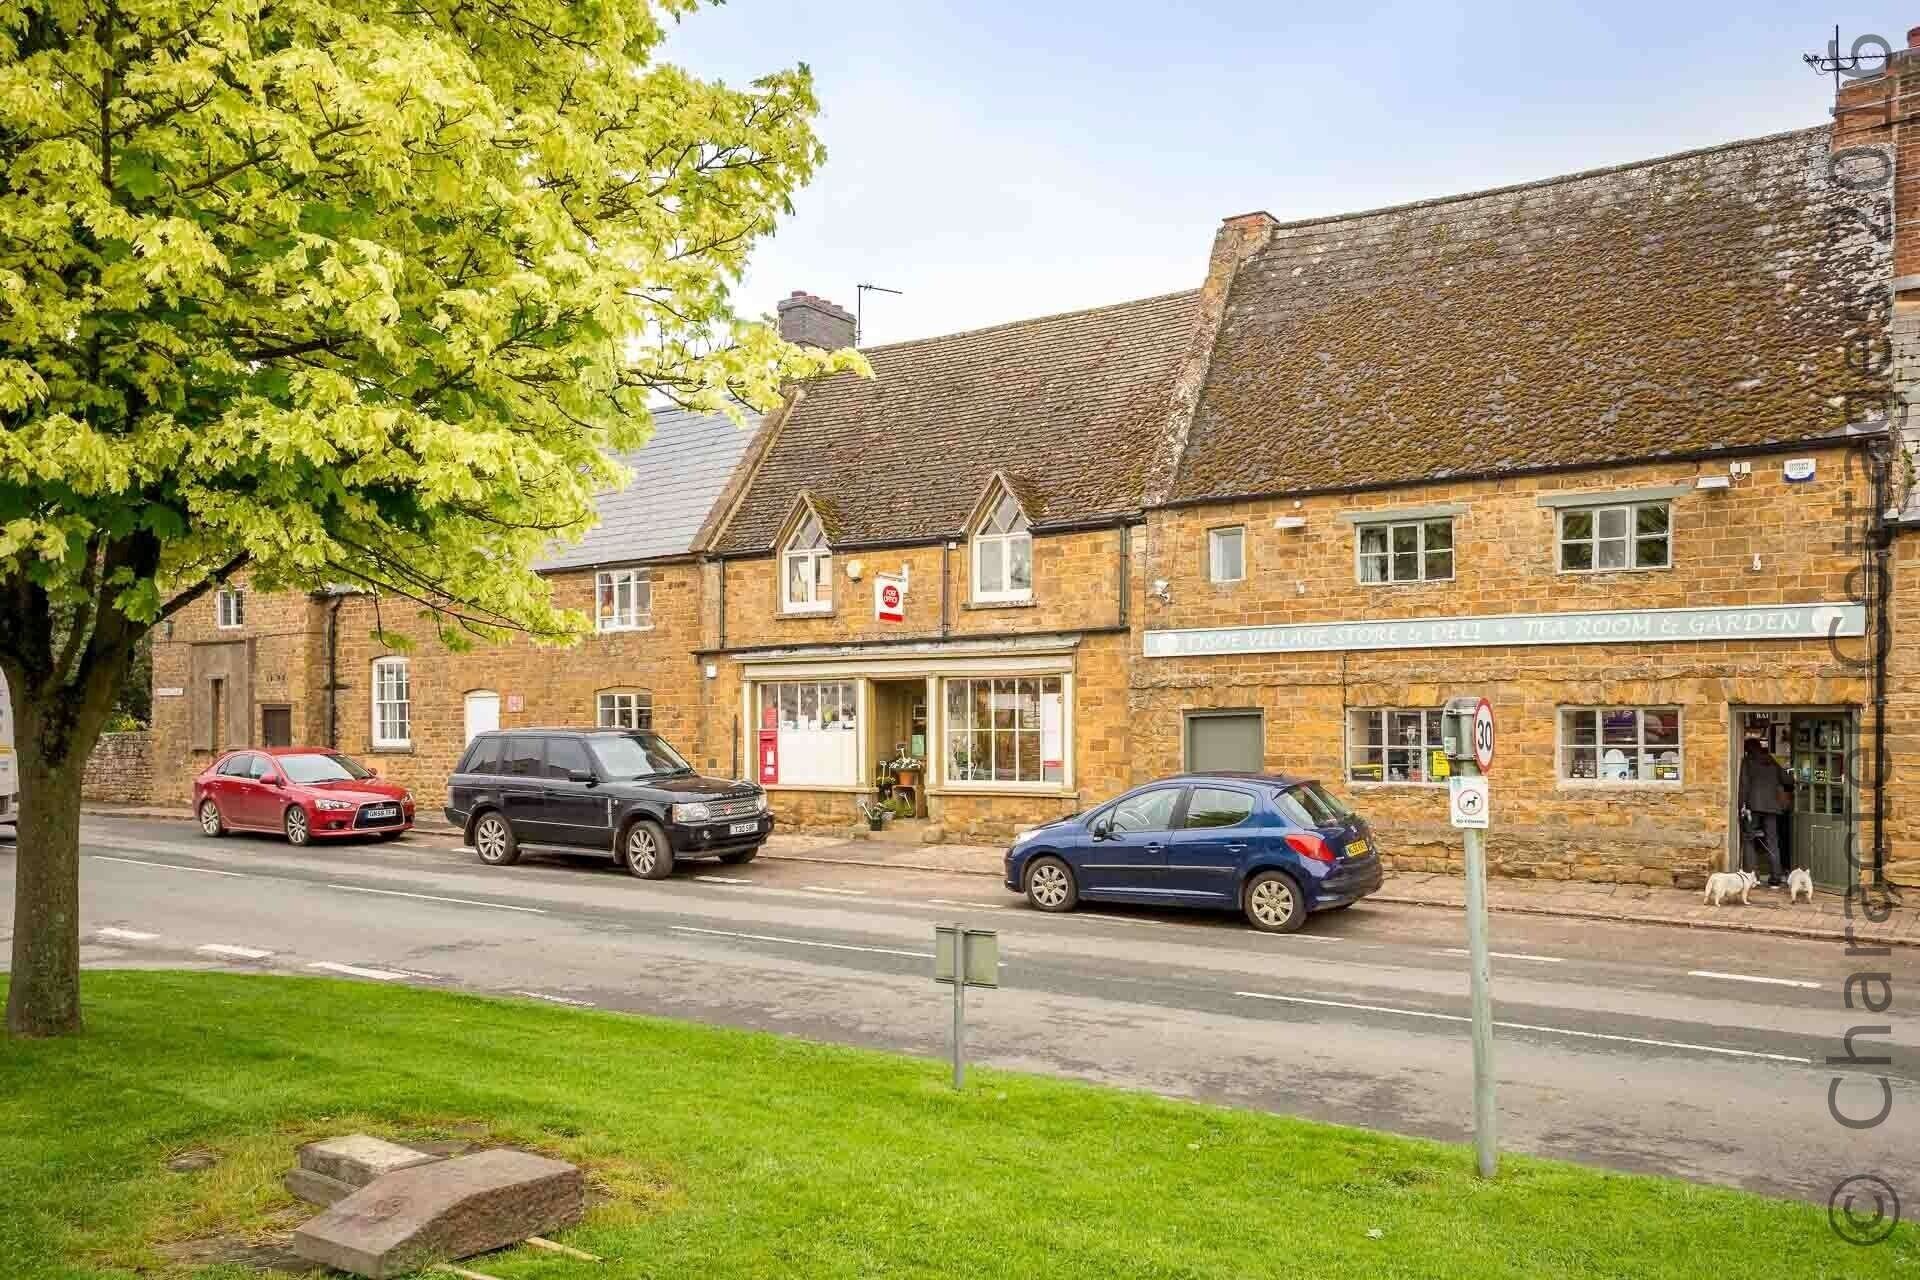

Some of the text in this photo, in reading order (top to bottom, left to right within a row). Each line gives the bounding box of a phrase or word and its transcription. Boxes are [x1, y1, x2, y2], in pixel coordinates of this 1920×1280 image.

[1335, 627, 1399, 643] STORE
[1431, 621, 1481, 641] DELI
[1526, 618, 1565, 636] TEA
[1576, 615, 1651, 635] ROOM
[1661, 616, 1679, 634] &
[1688, 609, 1801, 632] GARDEN
[1477, 719, 1492, 751] 30
